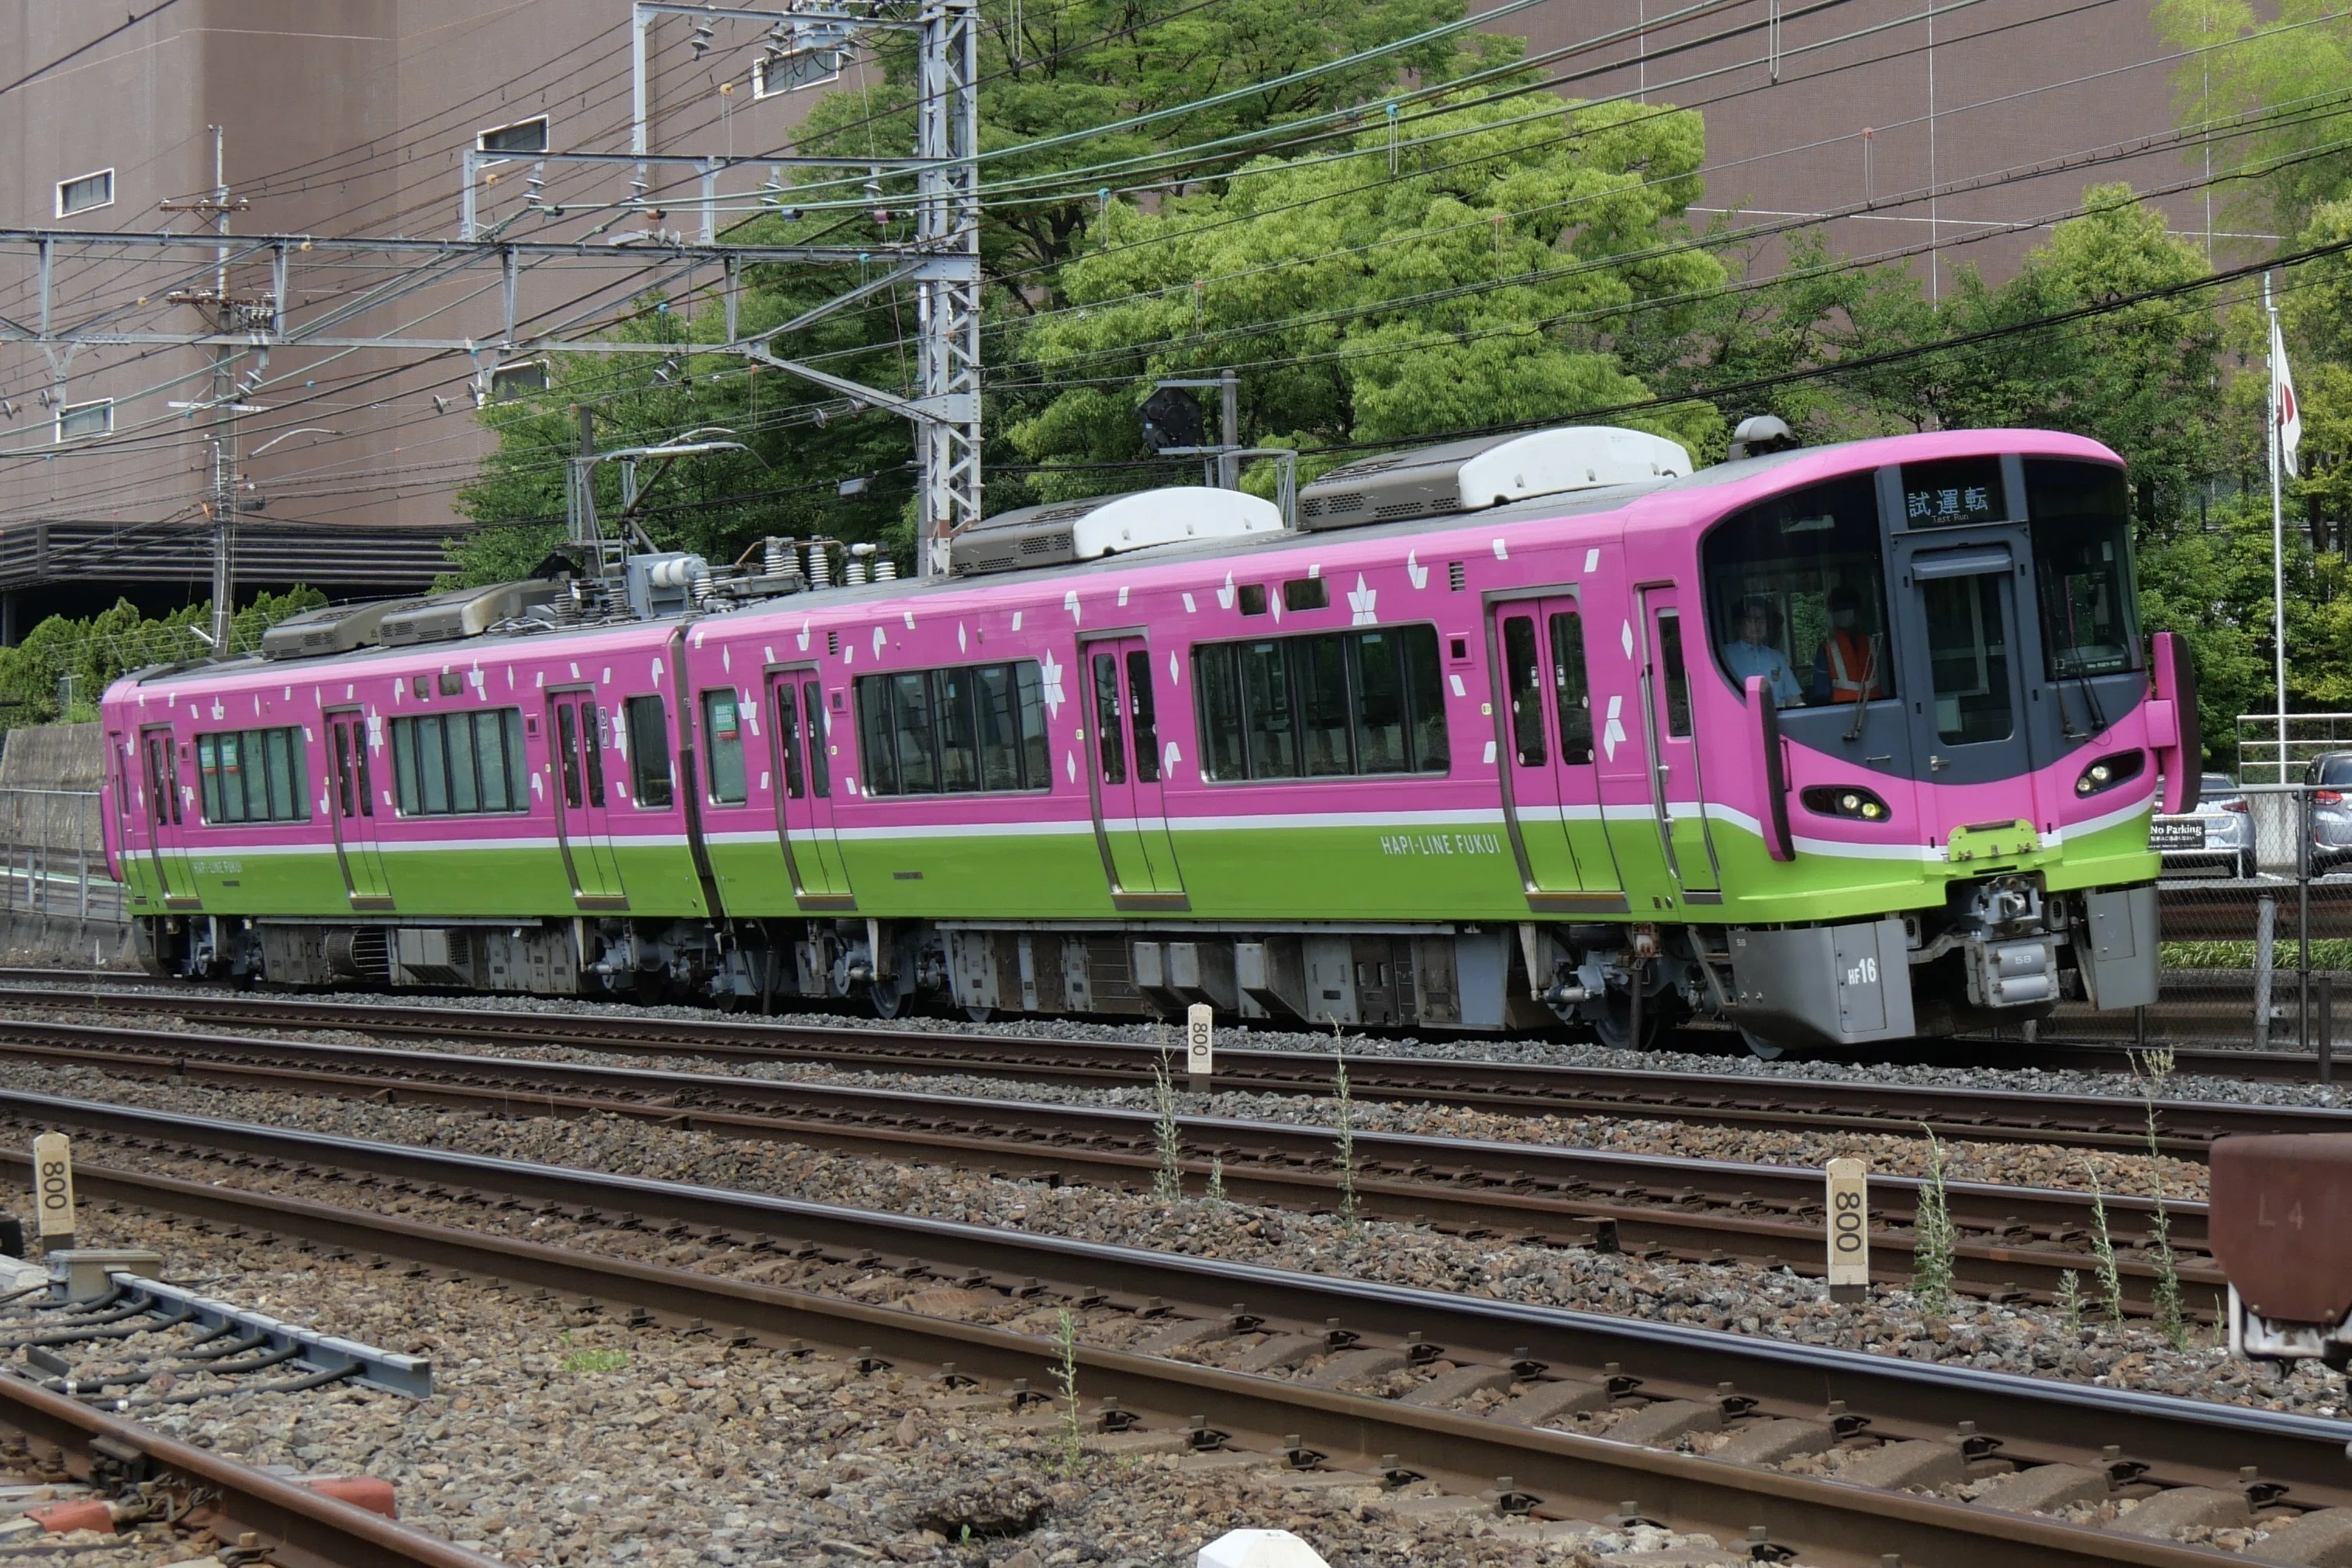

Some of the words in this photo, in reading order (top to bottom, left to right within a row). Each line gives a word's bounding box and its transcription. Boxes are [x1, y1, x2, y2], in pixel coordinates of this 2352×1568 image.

[1908, 486, 1988, 518] 試運転
[1931, 514, 1951, 523] Test
[1953, 513, 1969, 522] Run
[2150, 825, 2164, 834] No
[2167, 824, 2202, 836] Parking
[1380, 834, 1453, 855] HAPI-LINE
[1455, 834, 1501, 855] FUKUI
[1847, 957, 1877, 985] HF16
[2015, 955, 2032, 965] 58
[1193, 1022, 1208, 1056] 800
[43, 1161, 67, 1210] 800
[1835, 1191, 1861, 1252] 800
